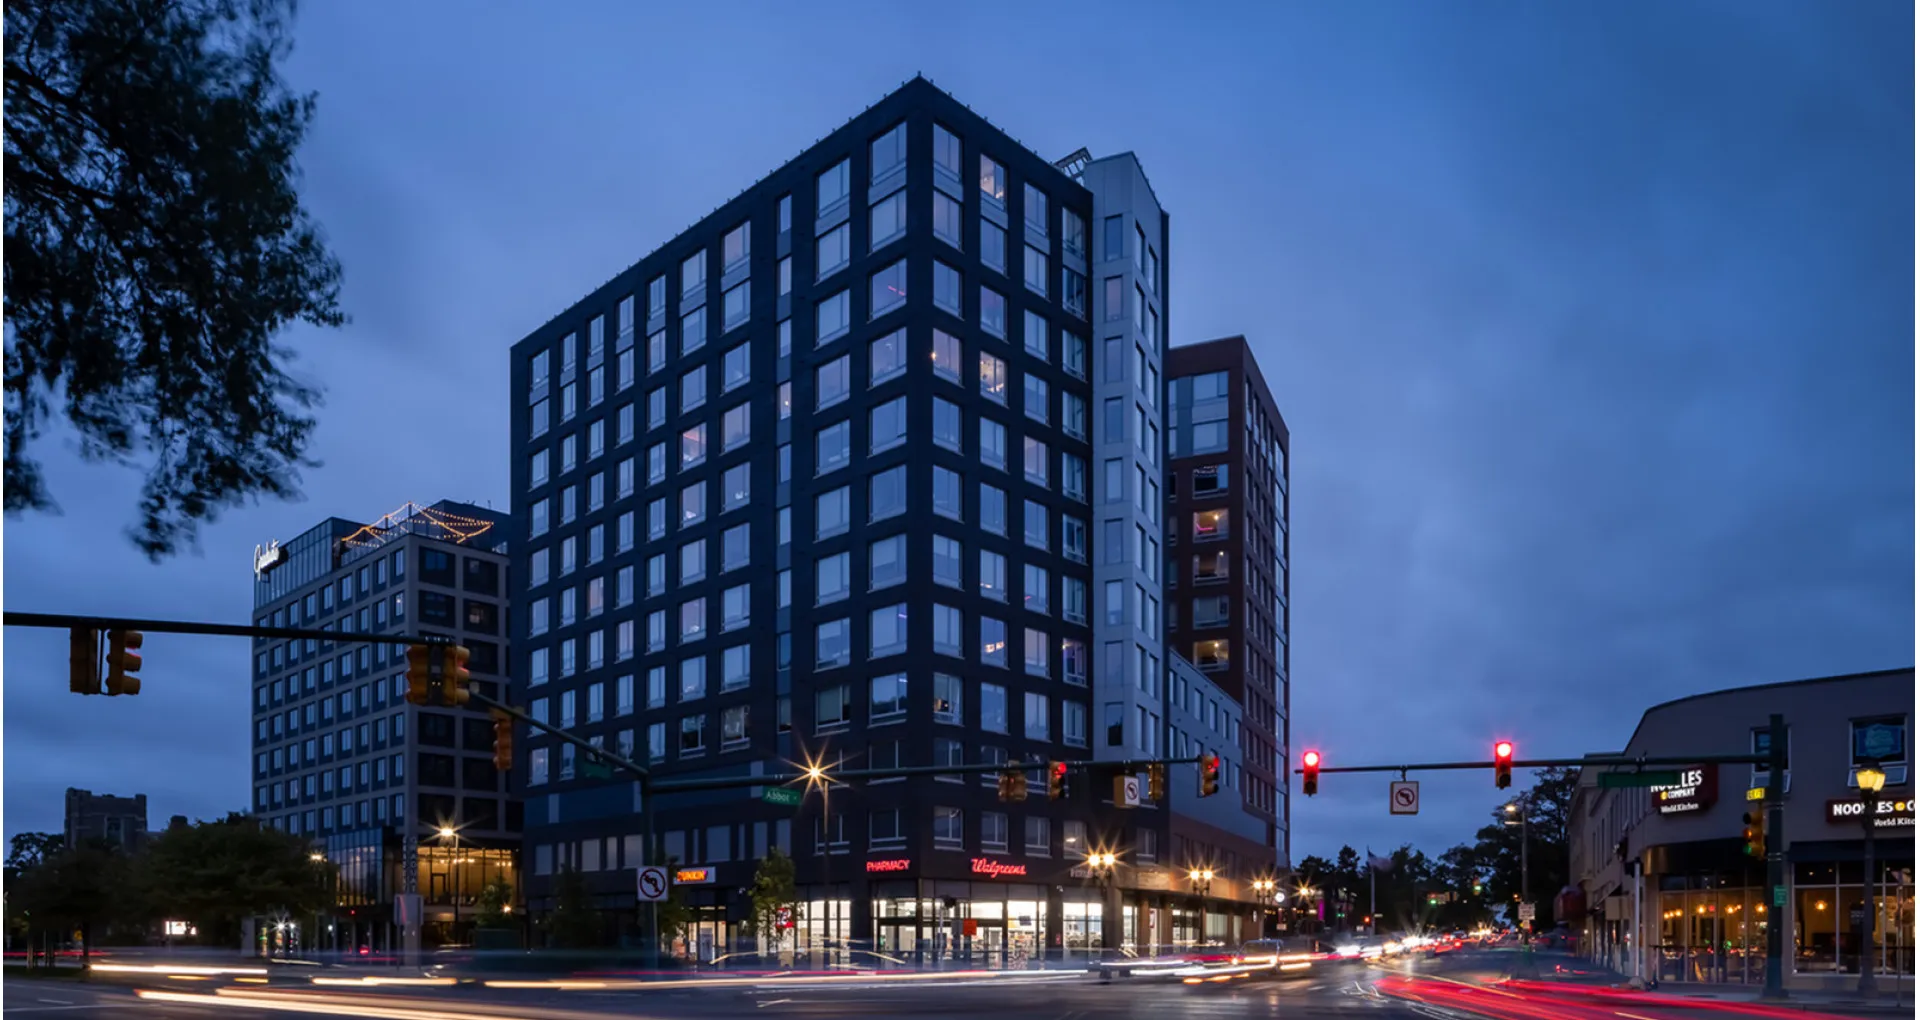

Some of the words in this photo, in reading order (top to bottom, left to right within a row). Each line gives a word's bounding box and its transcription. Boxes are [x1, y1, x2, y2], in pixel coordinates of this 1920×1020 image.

[766, 790, 790, 803] Abbot
[866, 859, 911, 872] PHARMACY
[971, 858, 1026, 879] Walgreens
